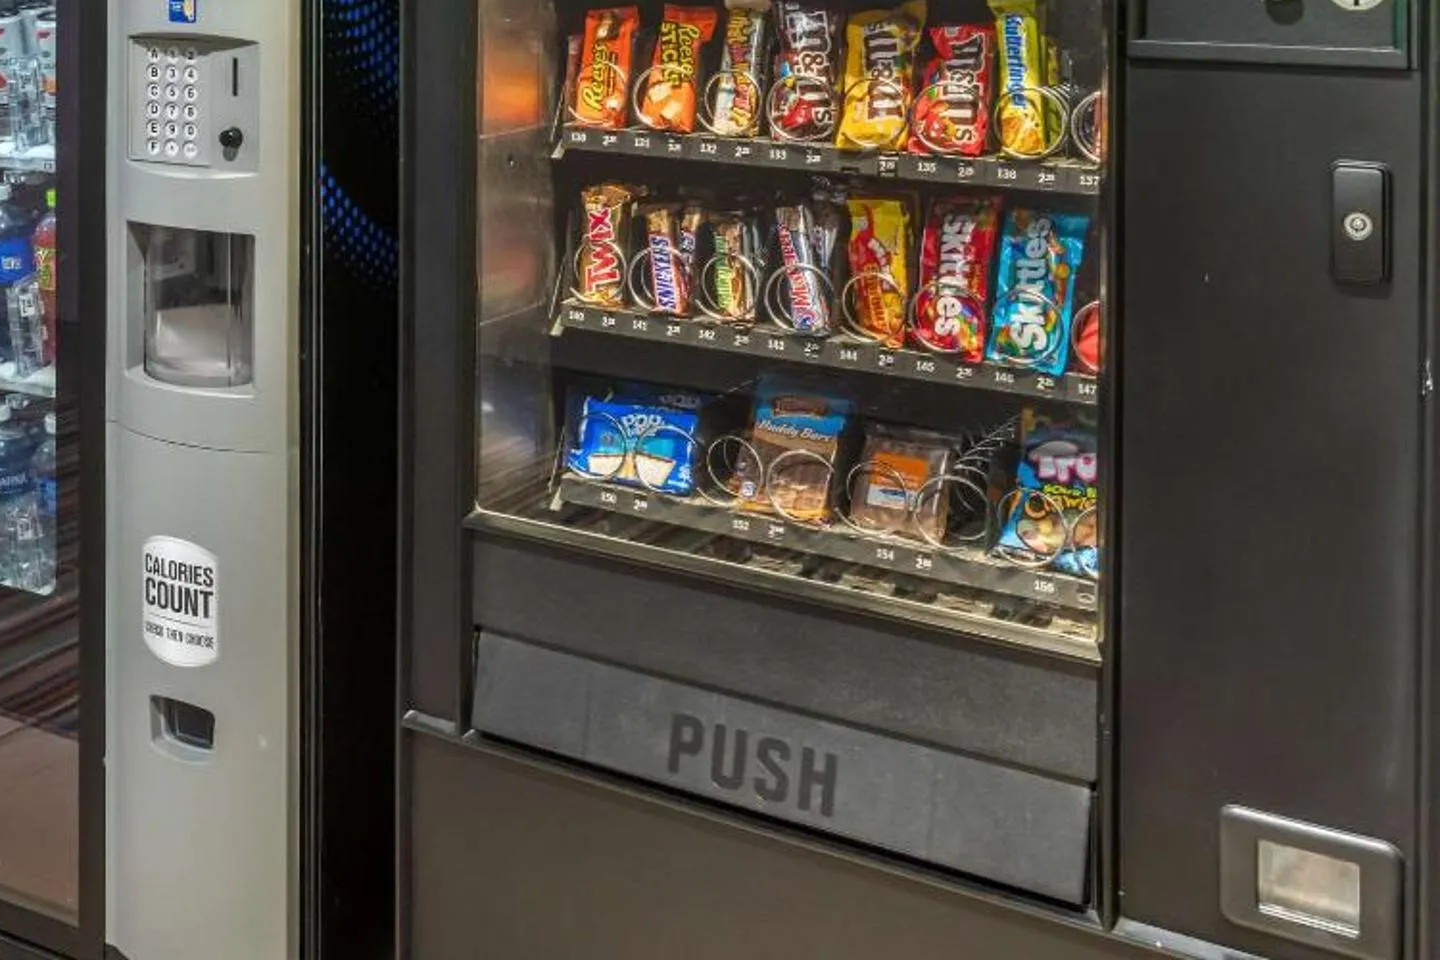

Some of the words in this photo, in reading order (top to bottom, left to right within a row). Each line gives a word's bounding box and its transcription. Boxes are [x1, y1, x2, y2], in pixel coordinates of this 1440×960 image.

[151, 67, 158, 77] B
[151, 123, 158, 133] E
[584, 207, 620, 290] TWIX
[650, 235, 677, 311] SNICKERS
[145, 552, 214, 587] CALORIES
[145, 577, 213, 619] COUNT
[667, 712, 839, 818] PUSH
